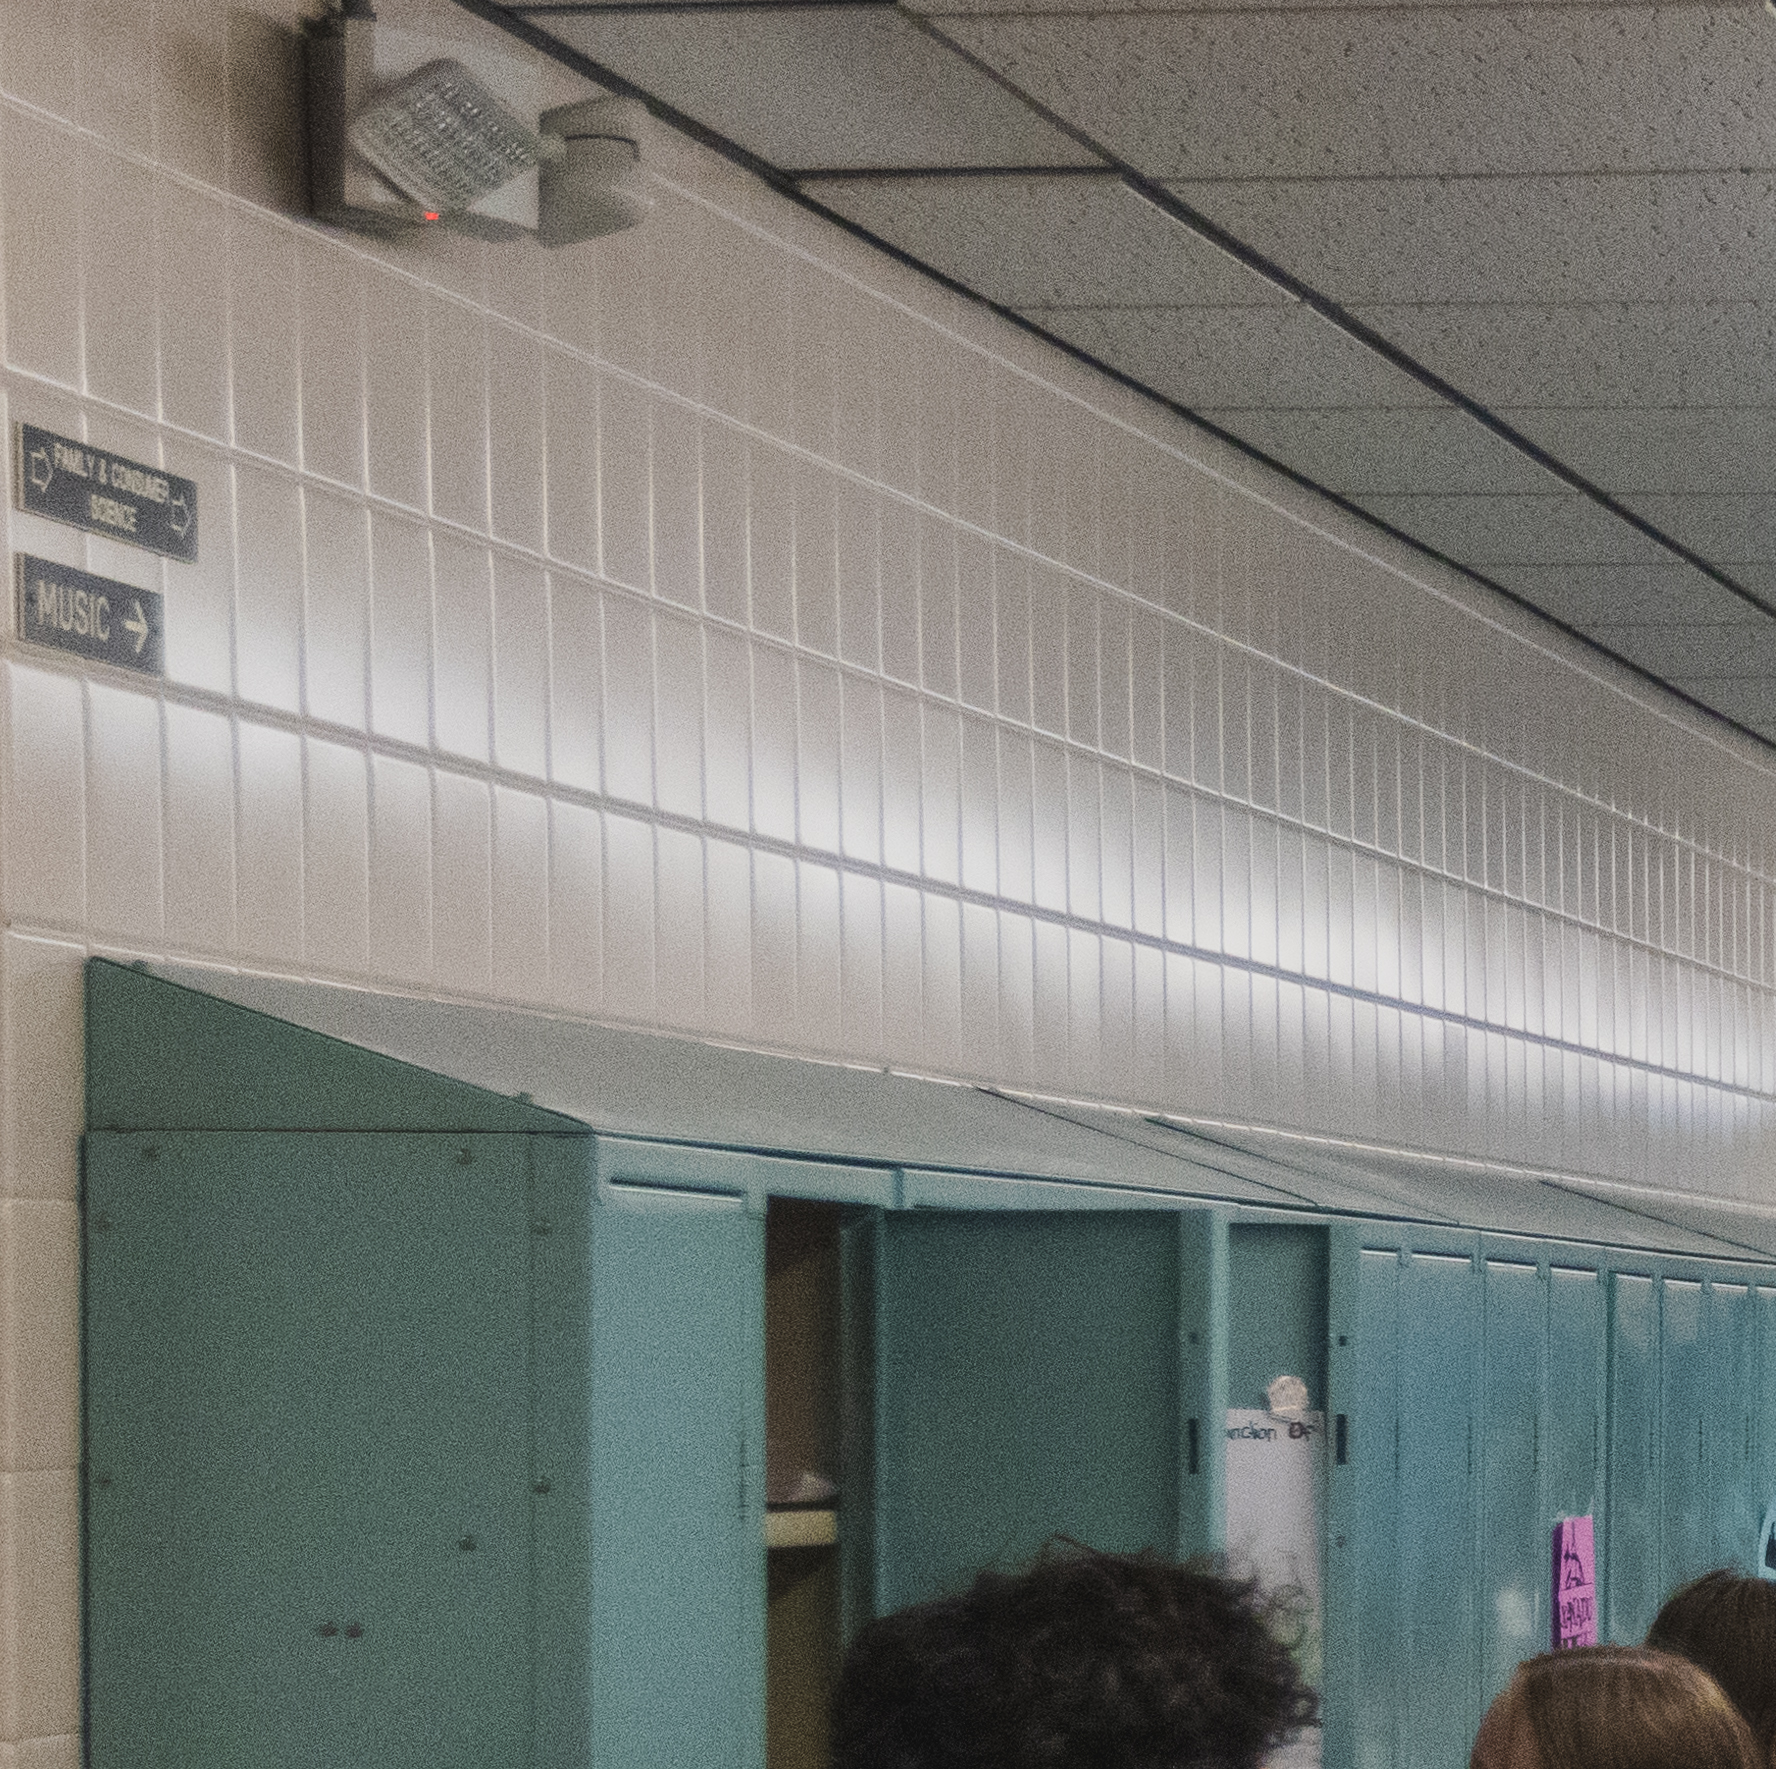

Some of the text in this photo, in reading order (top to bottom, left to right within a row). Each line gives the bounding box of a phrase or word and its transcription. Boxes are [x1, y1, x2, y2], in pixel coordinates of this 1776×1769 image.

[53, 442, 170, 505] FAMILY & CONSUMER
[90, 495, 137, 532] SCIENCE
[36, 579, 111, 641] MUSIC
